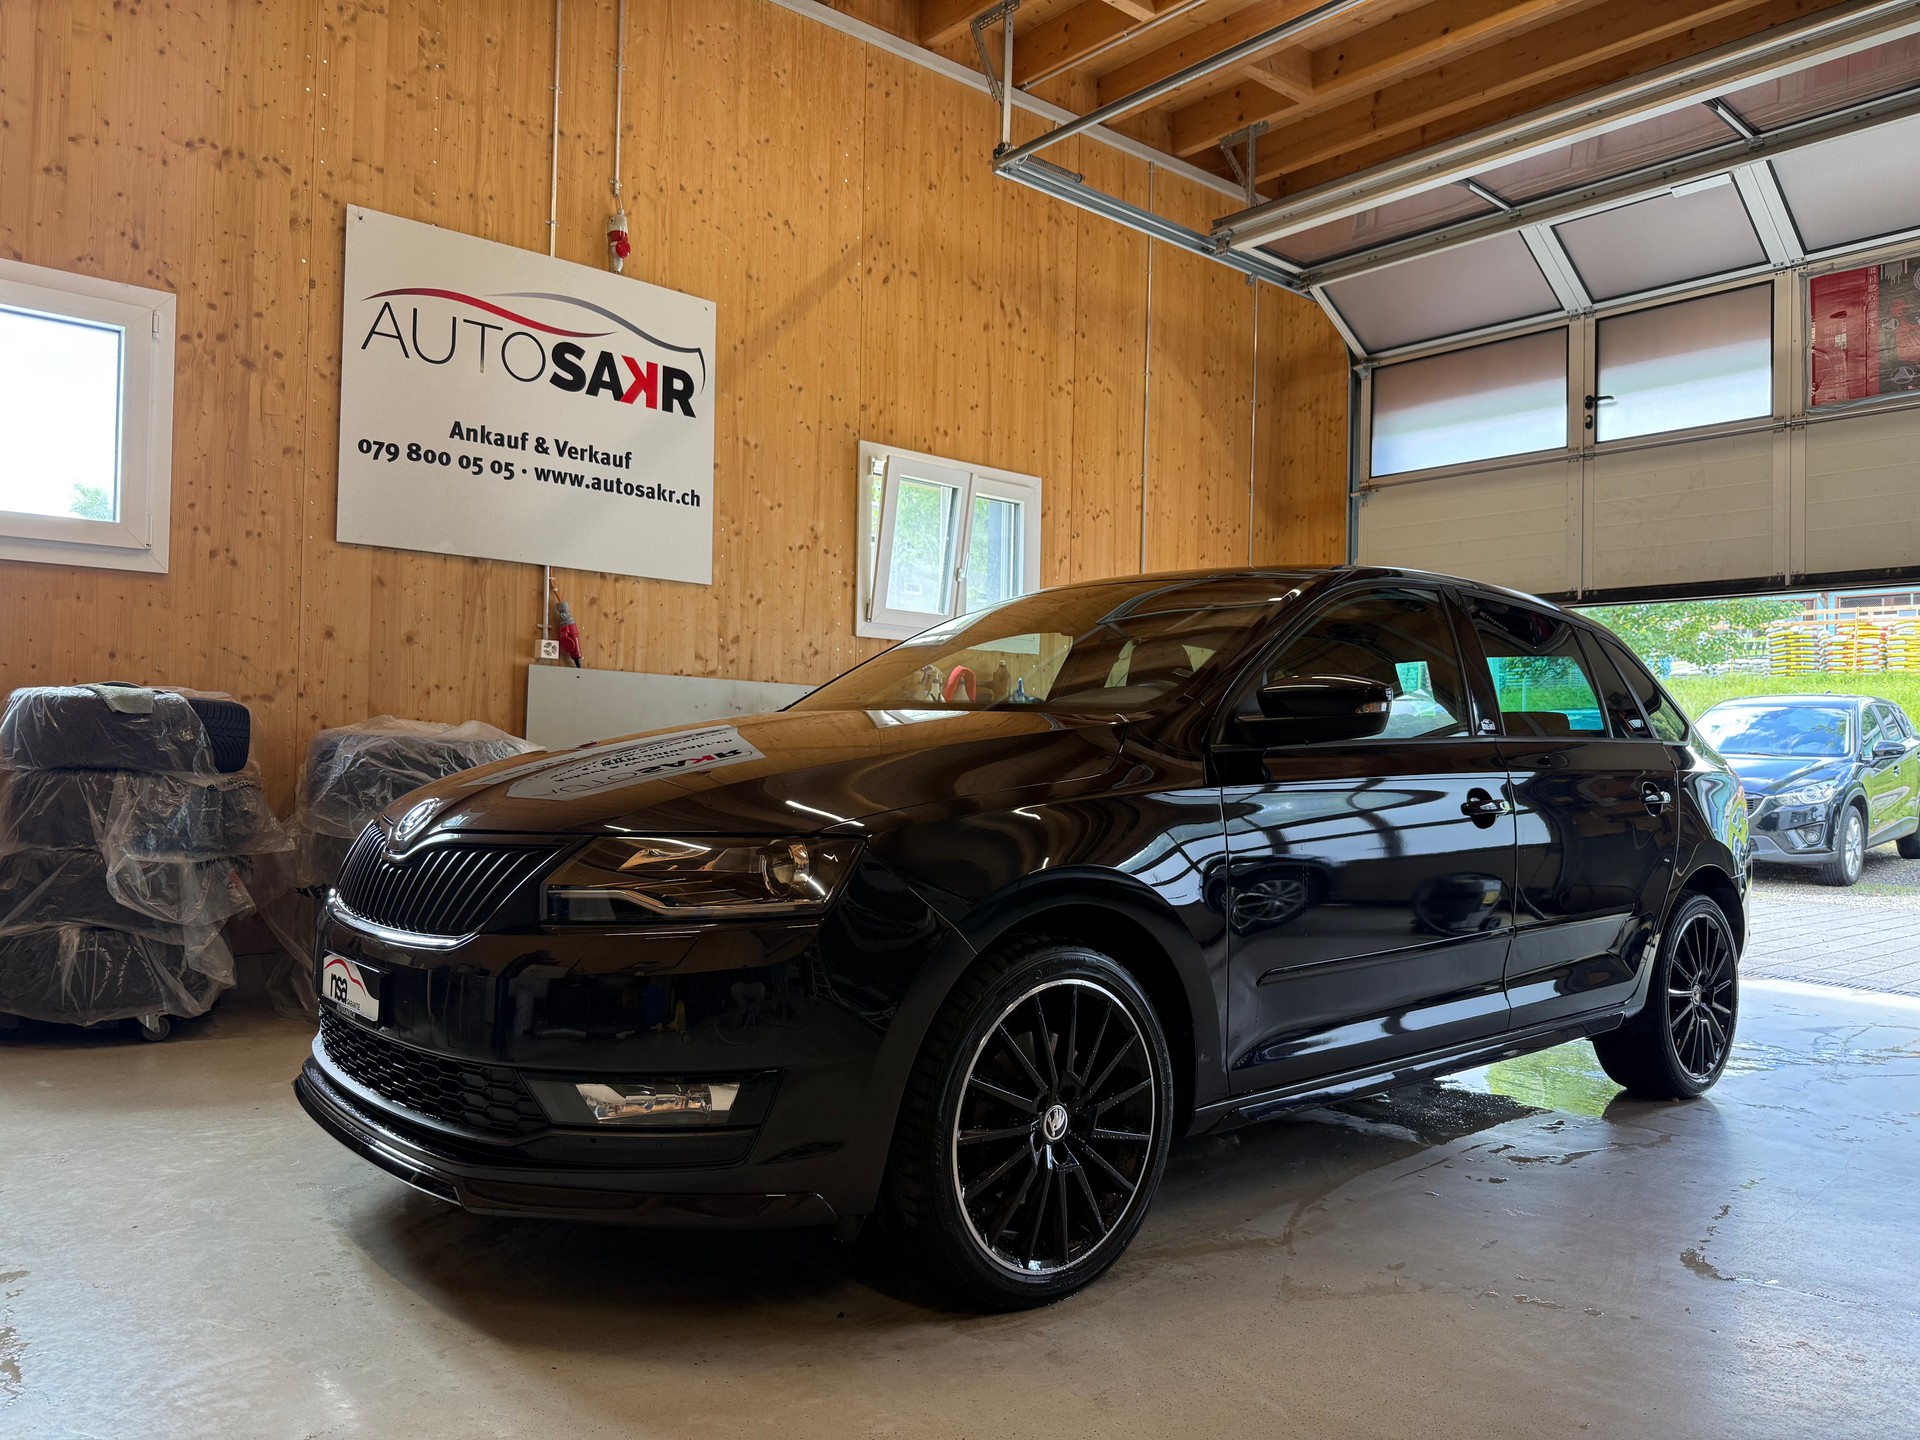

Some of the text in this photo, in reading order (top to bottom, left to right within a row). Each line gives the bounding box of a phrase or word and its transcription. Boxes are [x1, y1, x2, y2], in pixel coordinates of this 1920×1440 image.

[361, 301, 697, 419] AUTOSAKR
[358, 439, 700, 507] 079 800 05 05 www.autosakr.ch
[449, 421, 632, 469] Ankauf & Verkauf
[331, 973, 348, 1003] nsa
